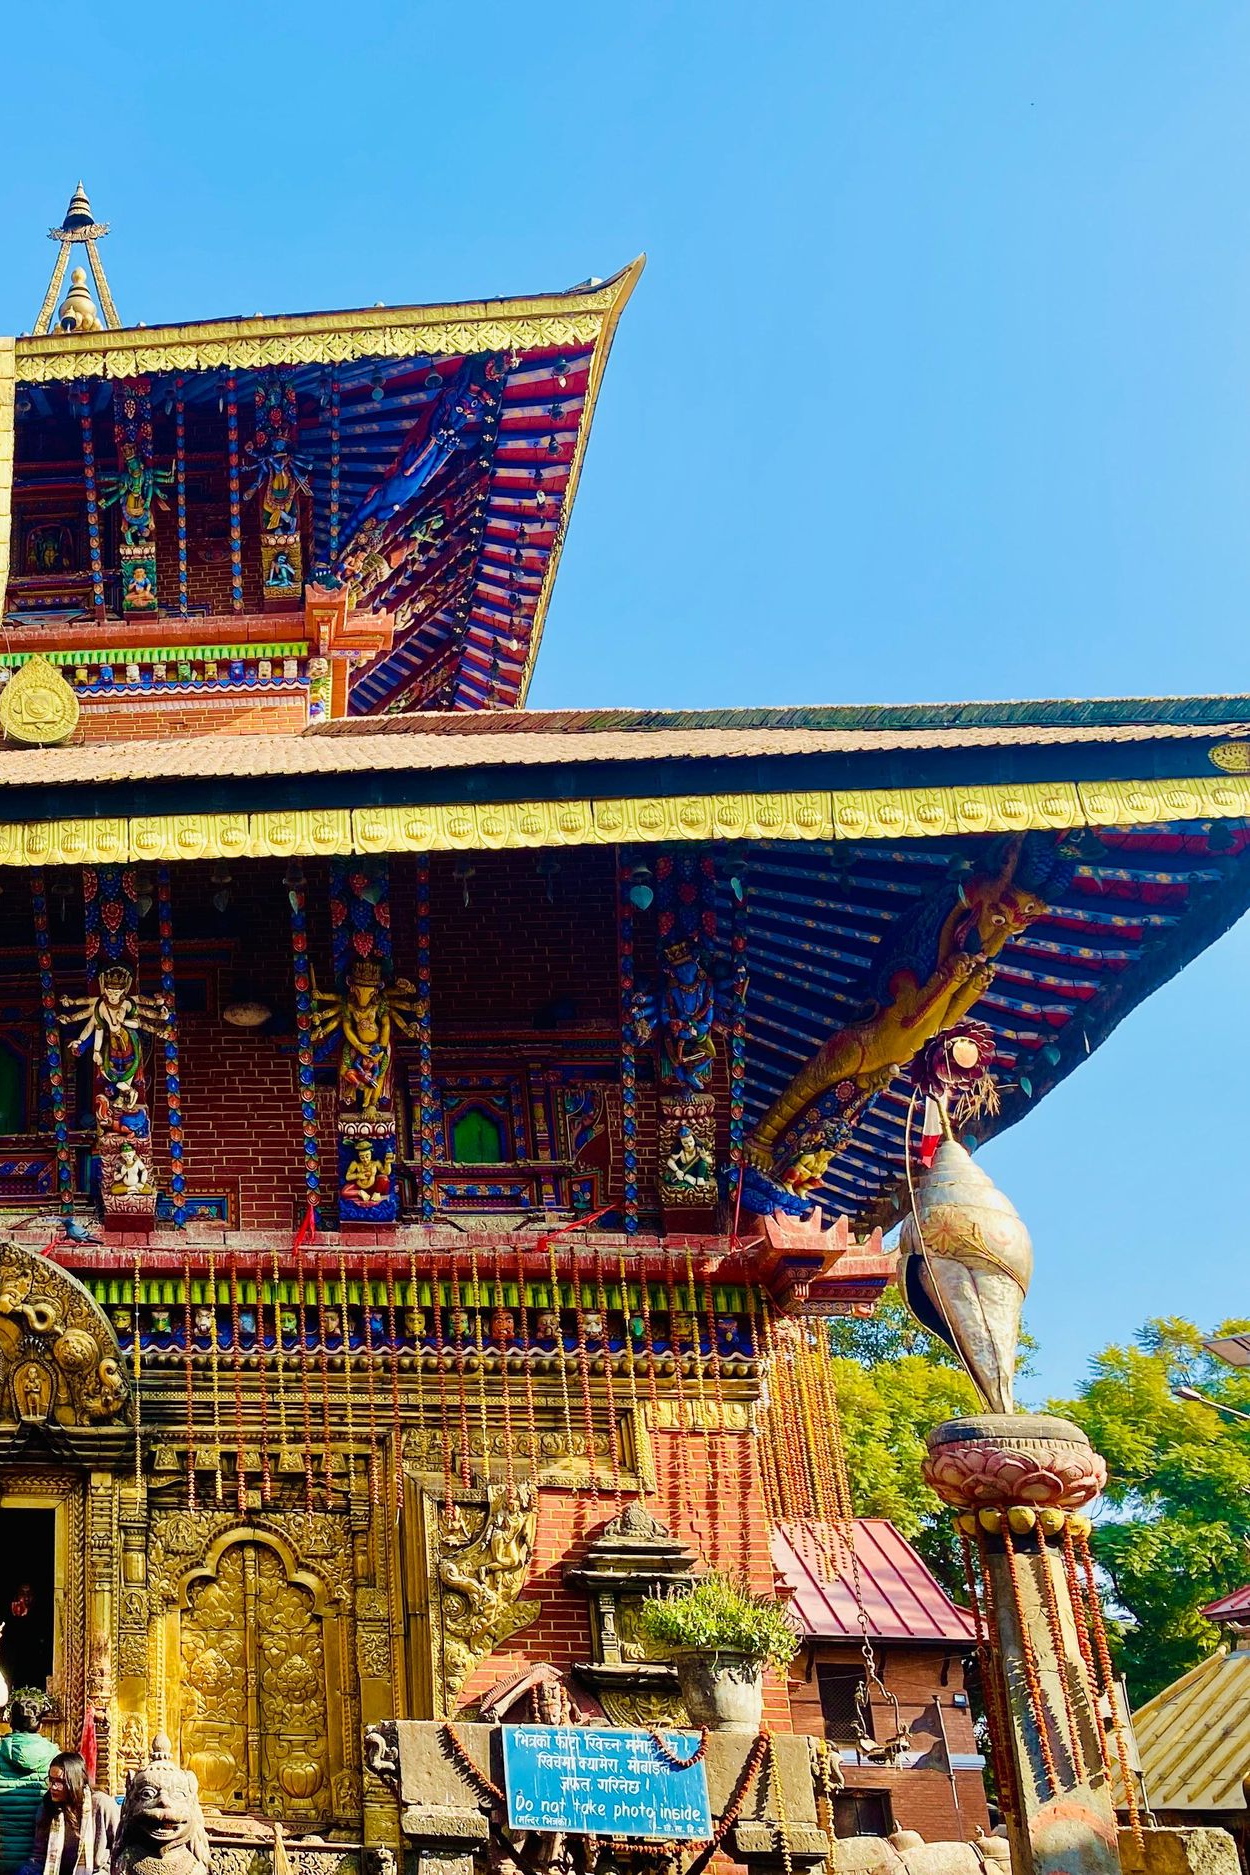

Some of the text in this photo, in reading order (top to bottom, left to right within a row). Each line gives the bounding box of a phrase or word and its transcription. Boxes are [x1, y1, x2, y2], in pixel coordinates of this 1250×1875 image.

[516, 1794, 705, 1823] Do not take photo inside.
